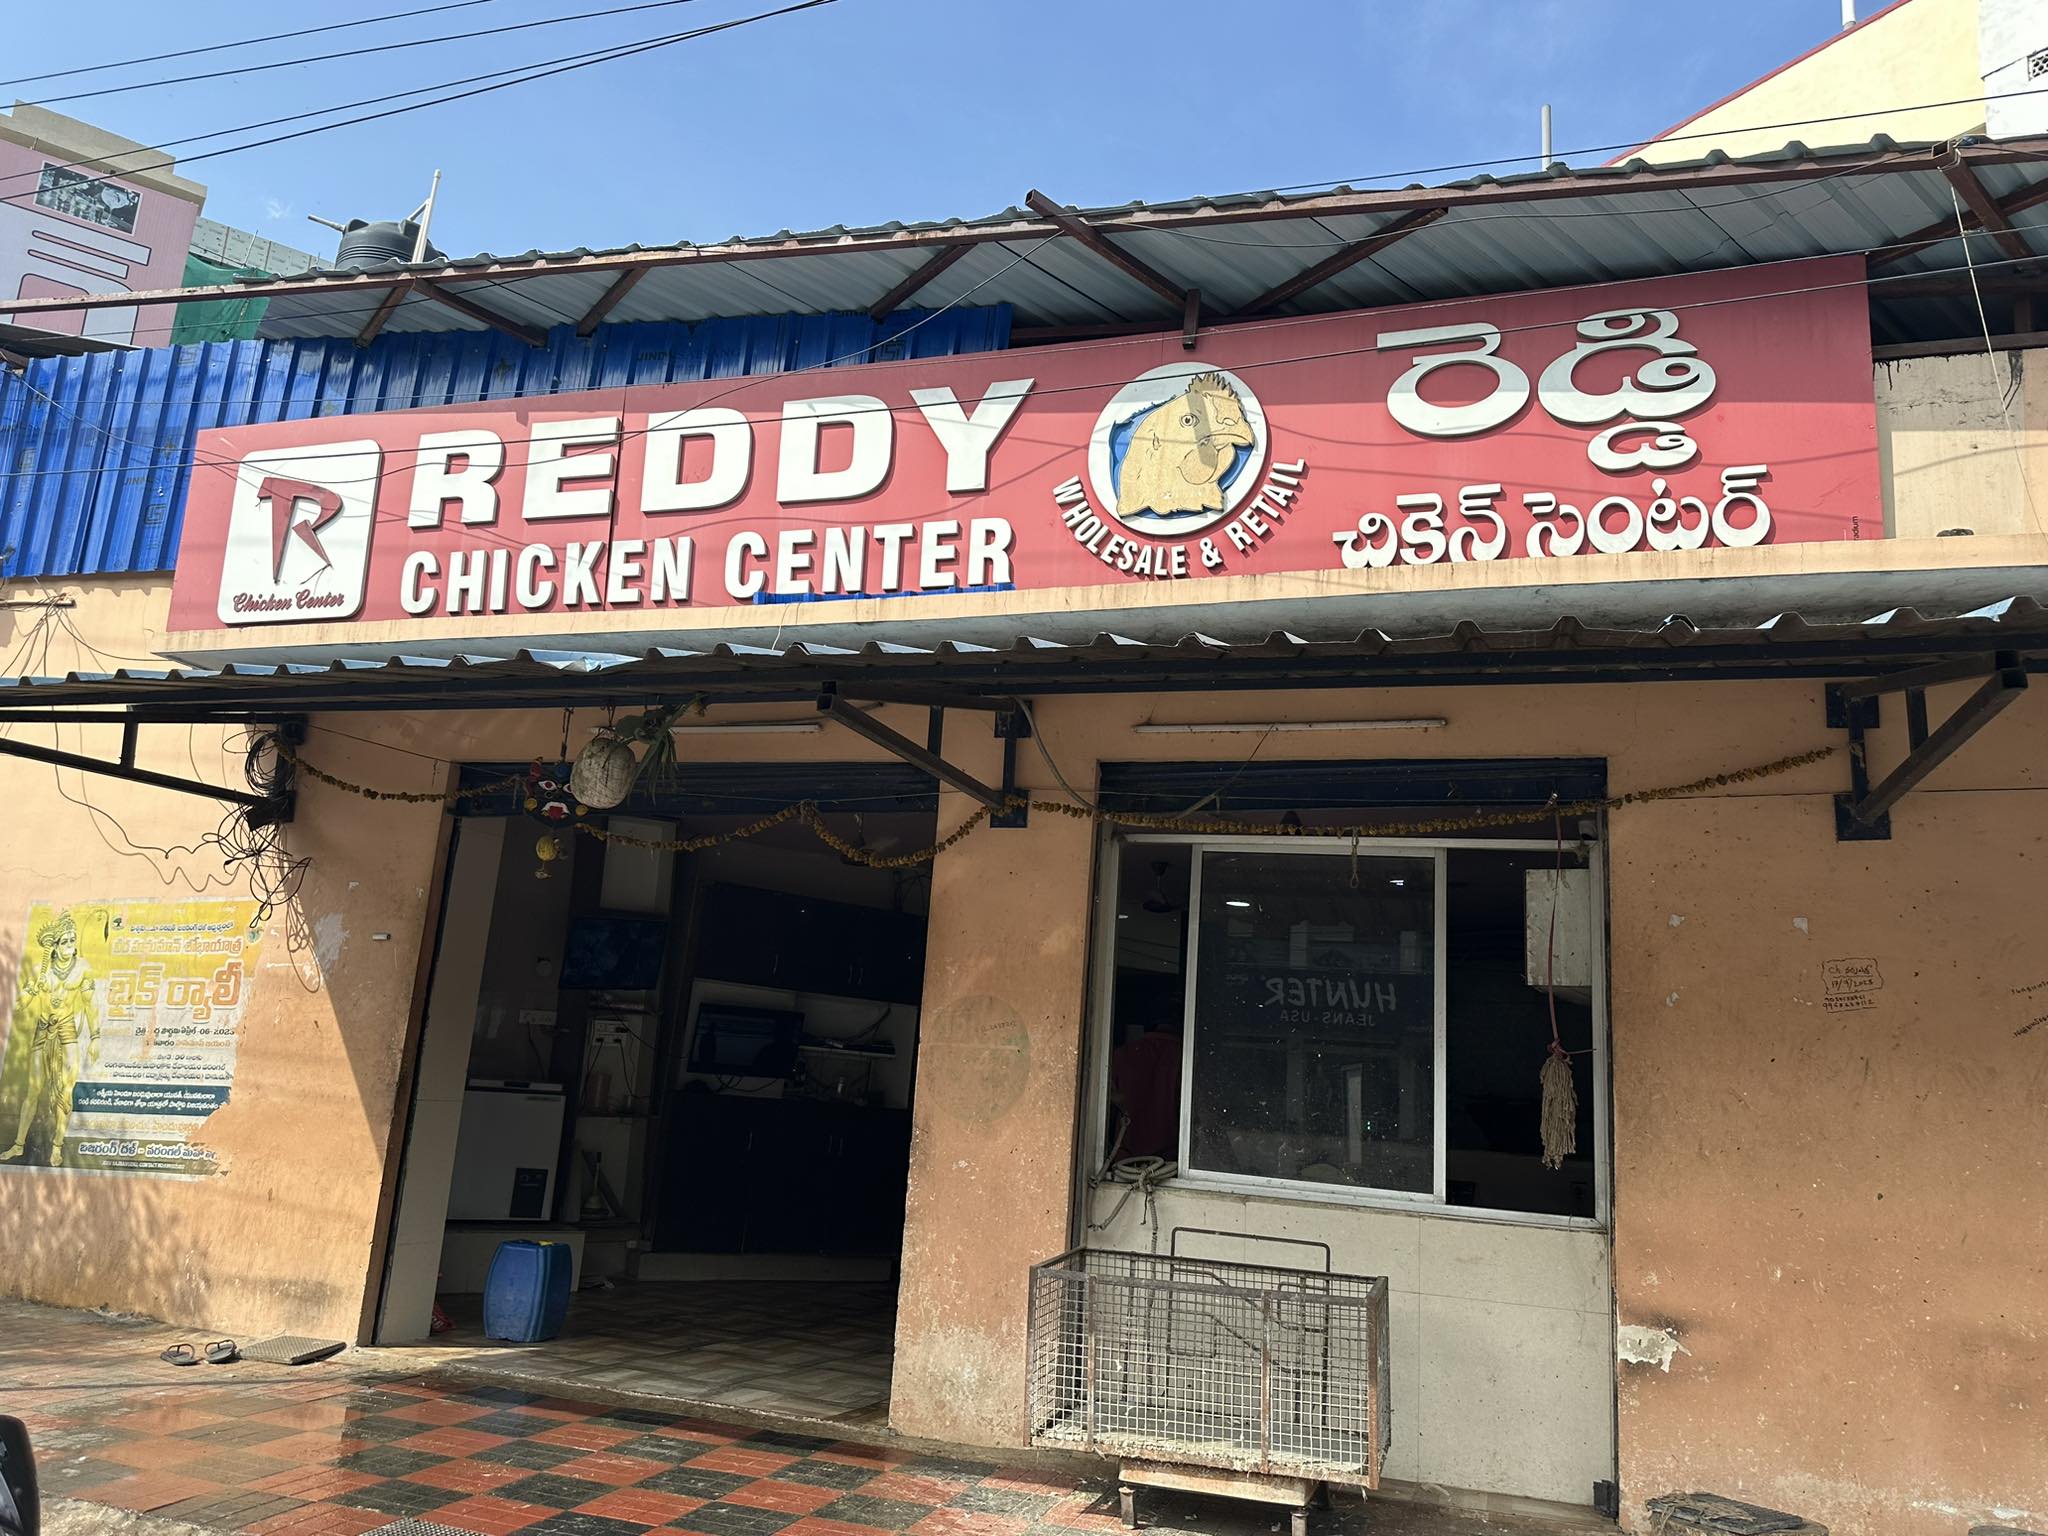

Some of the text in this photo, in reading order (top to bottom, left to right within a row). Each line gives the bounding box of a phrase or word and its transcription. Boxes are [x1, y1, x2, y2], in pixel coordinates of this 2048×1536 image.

[1376, 308, 1717, 471] రెడ్డి
[407, 376, 1036, 529] REDDY
[401, 517, 1017, 615] CHICKEN CENTER
[1052, 457, 1306, 577] WHOLESALE & RETAIL
[1332, 463, 1772, 569] చికెన్ సెంటర్
[233, 588, 345, 613] Chicken Center
